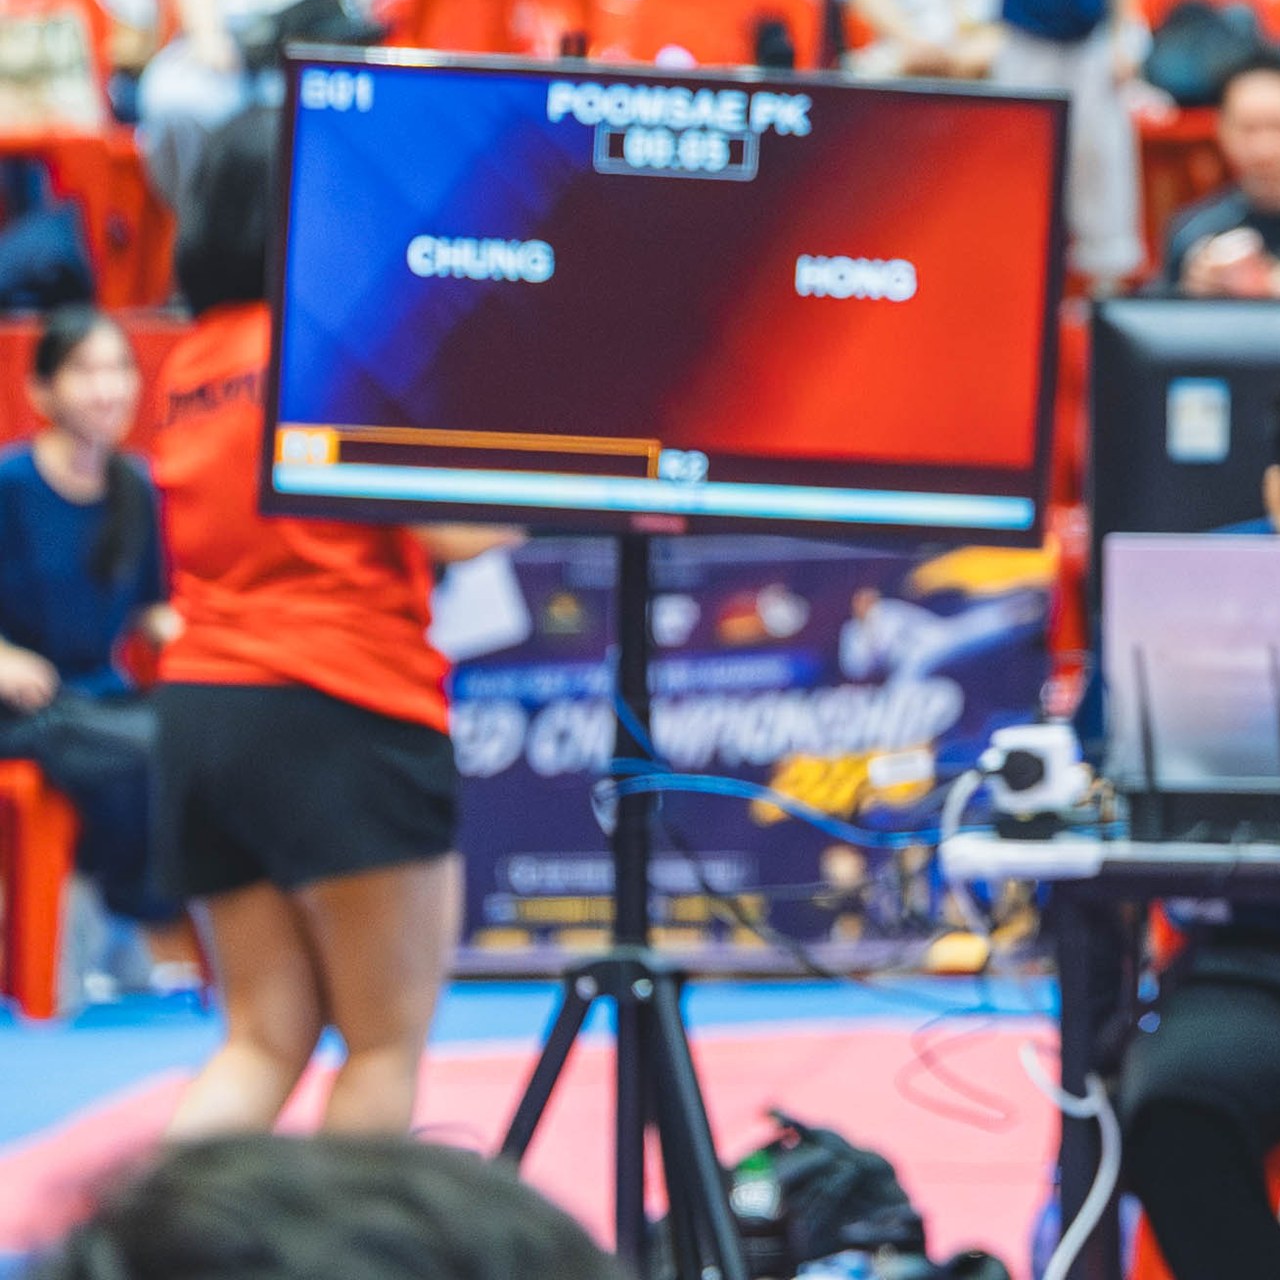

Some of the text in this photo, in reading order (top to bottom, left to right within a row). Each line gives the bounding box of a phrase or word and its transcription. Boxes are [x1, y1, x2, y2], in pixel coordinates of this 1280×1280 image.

[547, 79, 812, 137] POOMSAE PK
[407, 234, 555, 283] CHUNG
[795, 254, 918, 302] HONG
